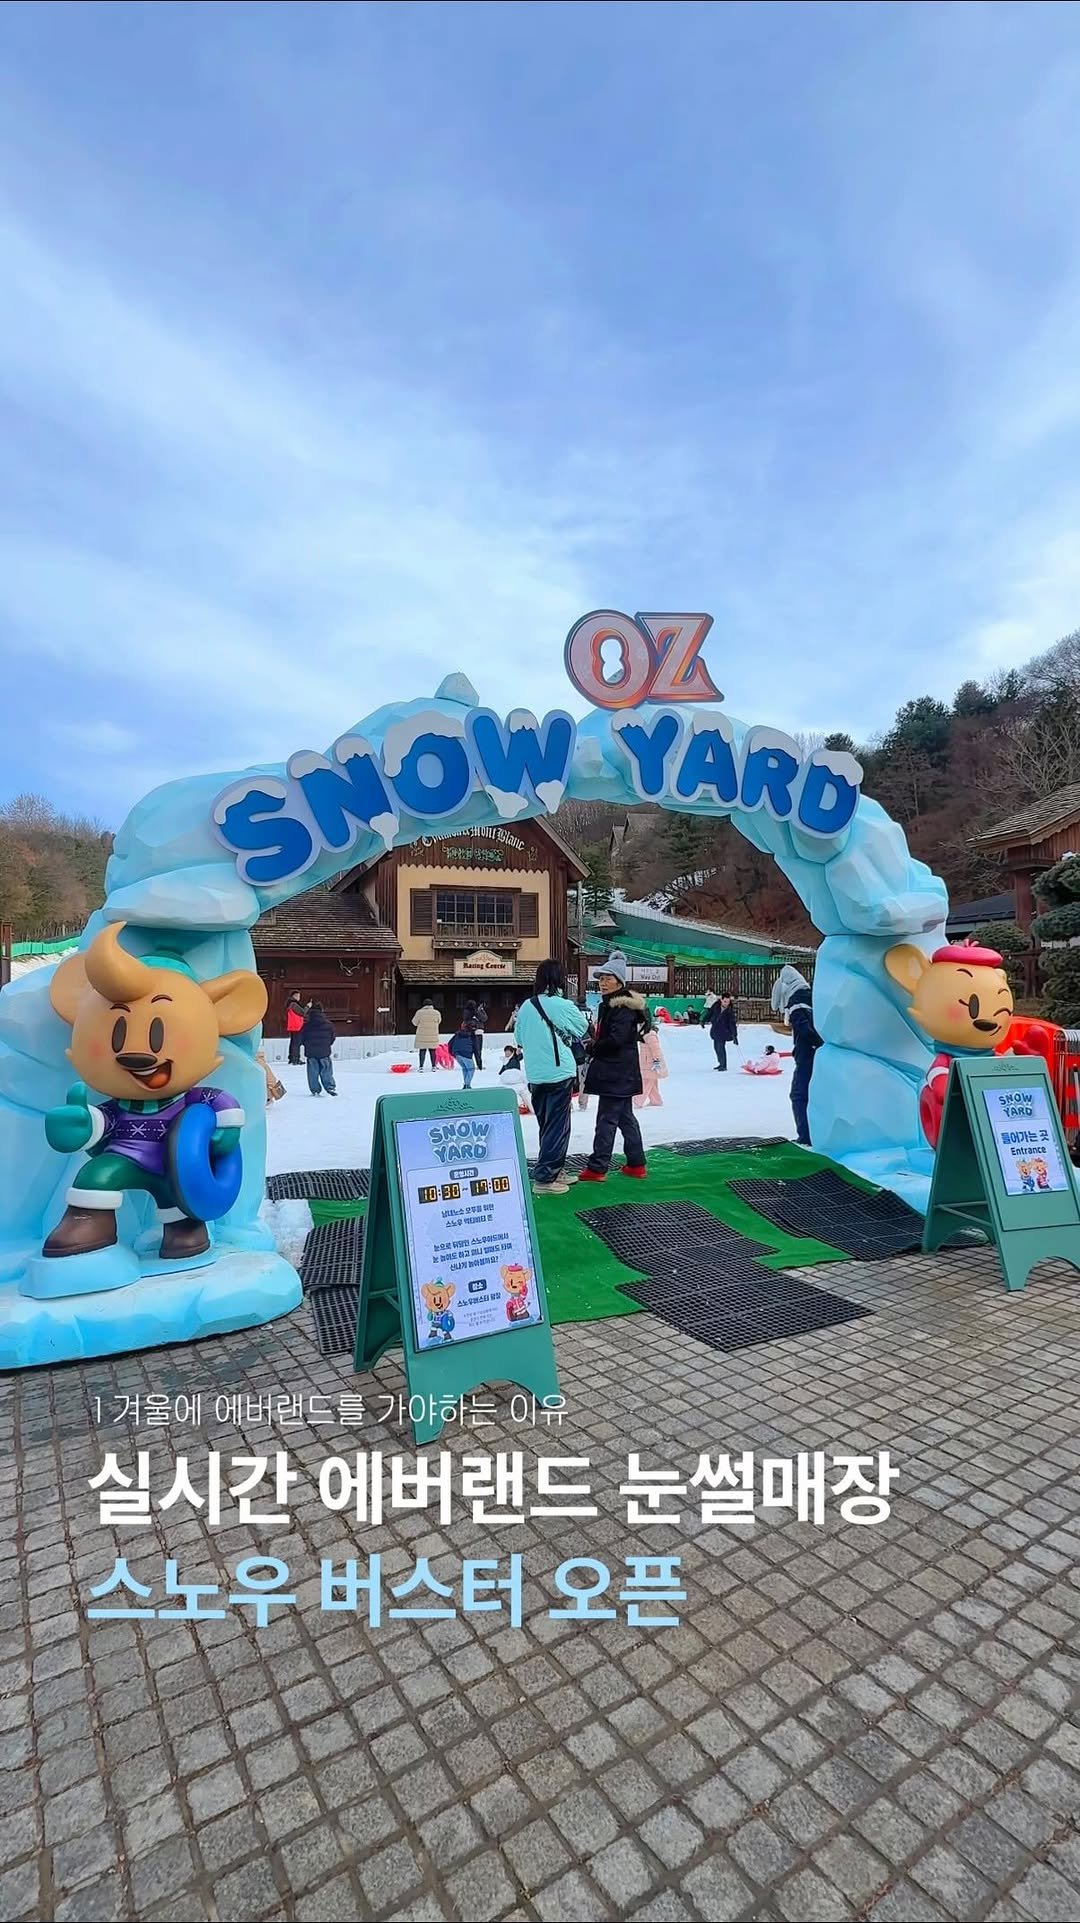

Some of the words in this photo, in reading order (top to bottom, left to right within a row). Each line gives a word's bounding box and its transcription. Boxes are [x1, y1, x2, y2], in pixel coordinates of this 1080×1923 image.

[564, 609, 724, 711] OZ
[216, 709, 574, 884] SNOW
[613, 709, 862, 837] YARD
[496, 827, 525, 851] Blanc
[999, 1092, 1033, 1106] SNOW
[1003, 1106, 1033, 1117] YARD
[429, 1120, 489, 1144] SNOW
[1001, 1131, 1038, 1144] 들어가는
[1039, 1129, 1049, 1141] 곳
[434, 1142, 487, 1162] YARD
[1011, 1146, 1047, 1155] Entrance
[421, 1183, 460, 1202] 10:30
[446, 1219, 463, 1228] 스노우
[458, 1250, 470, 1259] 하고
